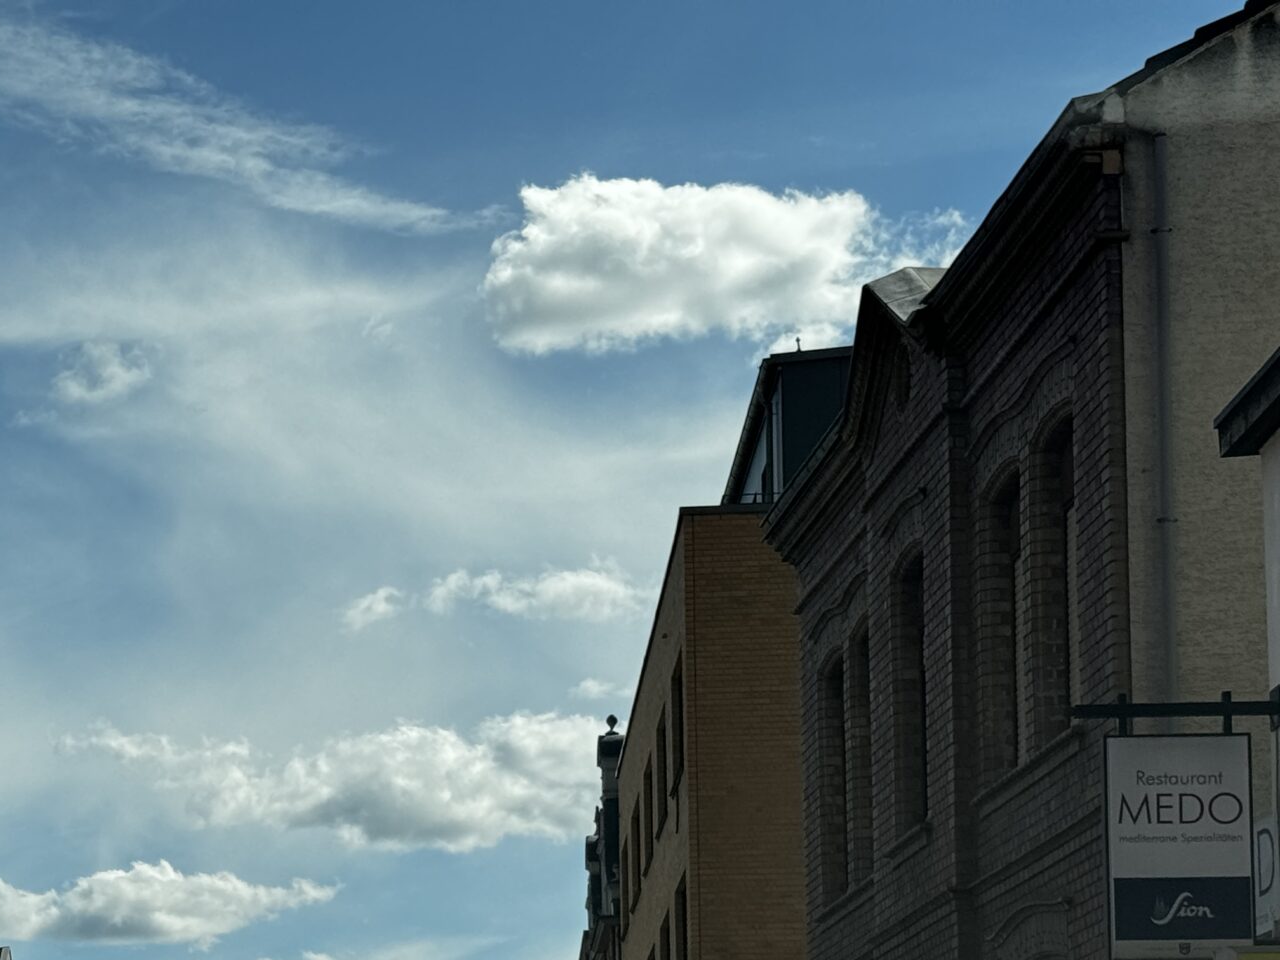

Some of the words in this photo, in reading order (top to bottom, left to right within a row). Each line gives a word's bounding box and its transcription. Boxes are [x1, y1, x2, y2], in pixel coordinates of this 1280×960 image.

[1136, 769, 1223, 786] Restaurant
[1118, 792, 1243, 825] MEDO
[1151, 891, 1215, 926] Sion
